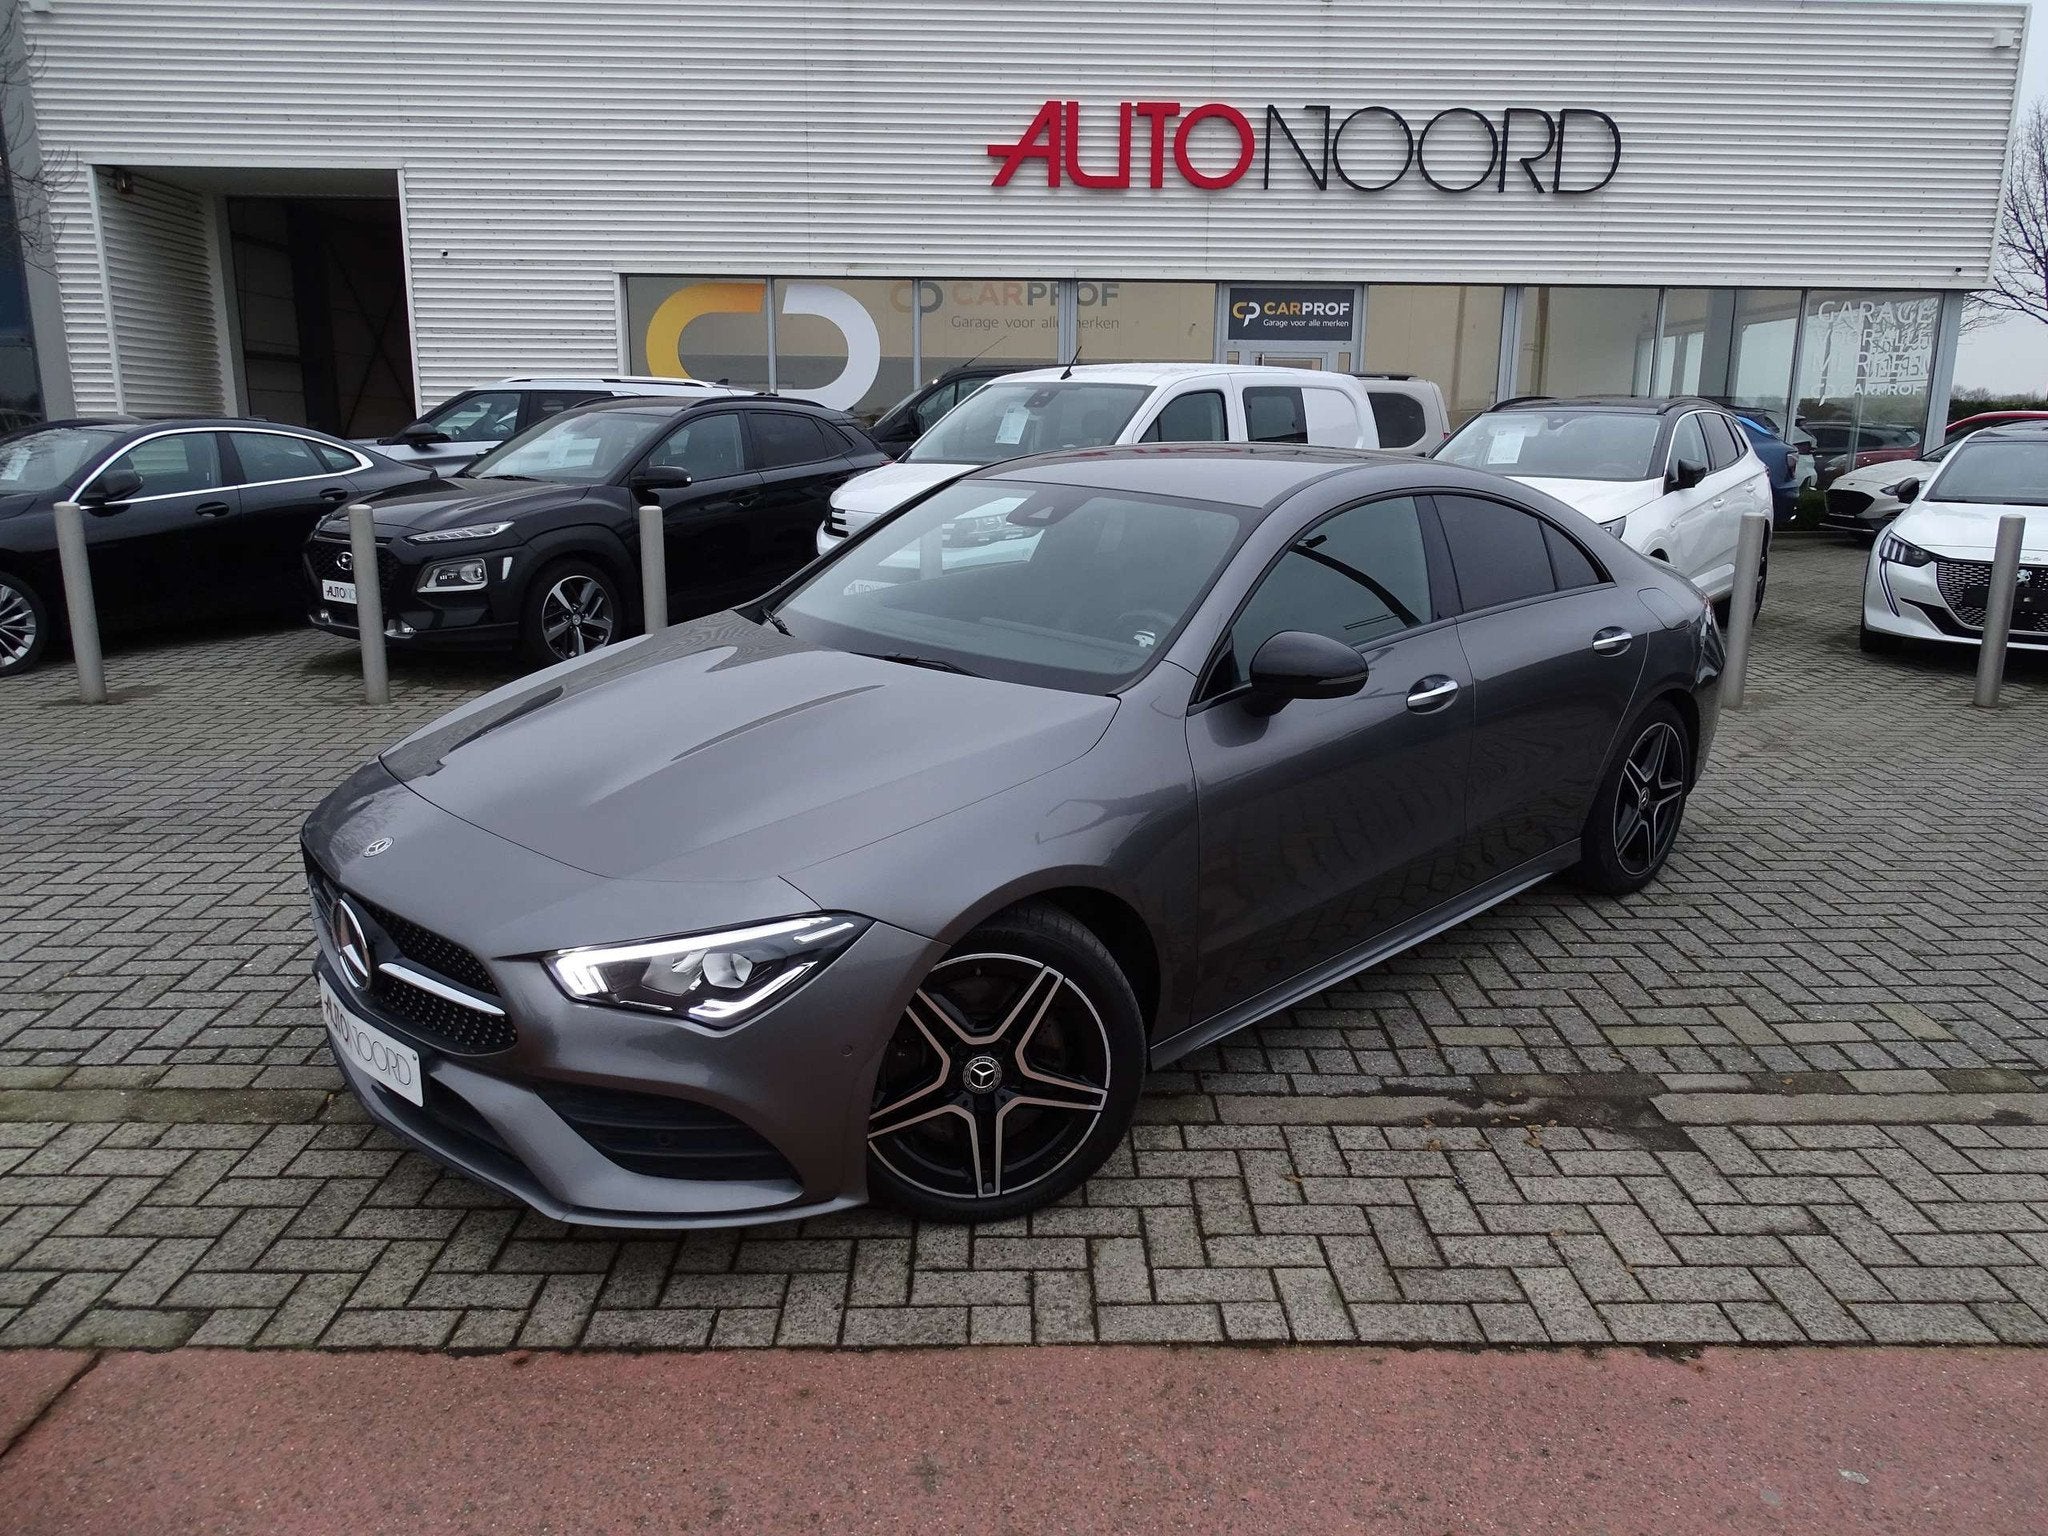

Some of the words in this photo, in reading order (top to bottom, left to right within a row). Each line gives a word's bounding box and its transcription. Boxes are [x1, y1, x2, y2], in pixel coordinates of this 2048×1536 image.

[987, 101, 1621, 195] AUTONOORD
[1263, 302, 1350, 315] CARPROF
[1818, 301, 1936, 323] GARAGE
[951, 315, 999, 329] Garage
[1006, 319, 1036, 328] voor
[1263, 319, 1288, 327] Garage
[1308, 319, 1320, 327] alle
[1322, 319, 1349, 327] merken
